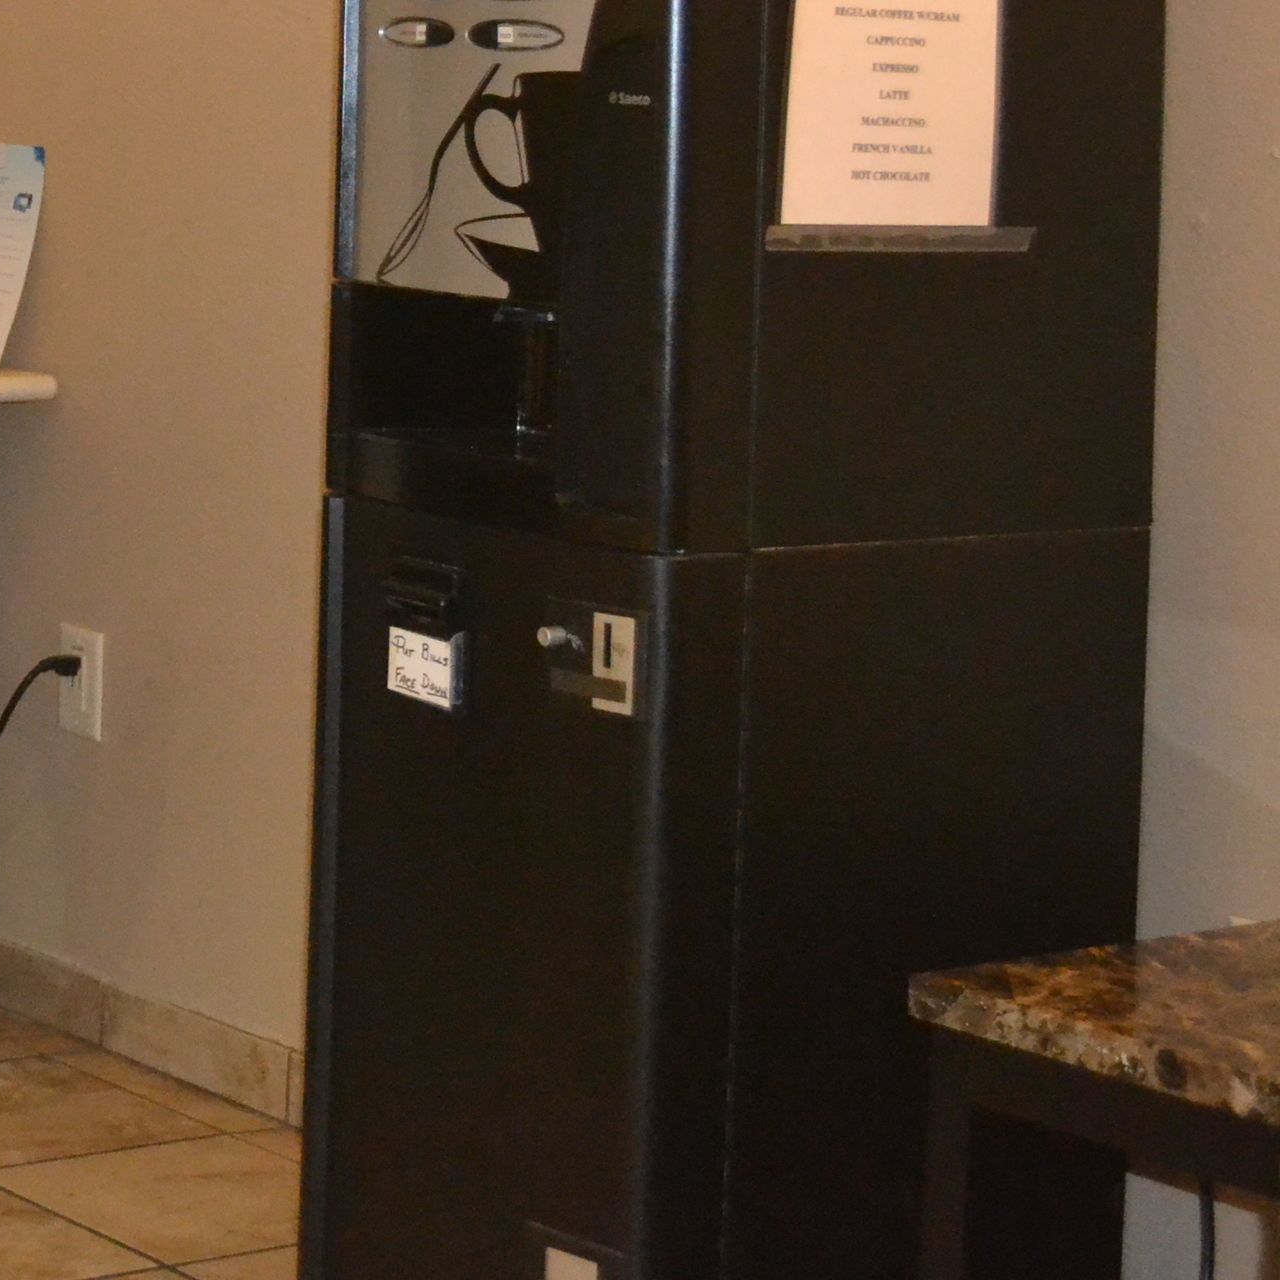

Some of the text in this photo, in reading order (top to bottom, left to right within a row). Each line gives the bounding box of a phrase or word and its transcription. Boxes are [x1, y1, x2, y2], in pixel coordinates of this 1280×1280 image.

[834, 6, 877, 18] REGULAR
[879, 9, 914, 20] COFFEE
[866, 35, 926, 47] CAPPUCCINO
[879, 90, 910, 100] LATTE
[852, 143, 932, 155] FRENCH VANILLA
[851, 170, 931, 182] HOT CHOCOLATE
